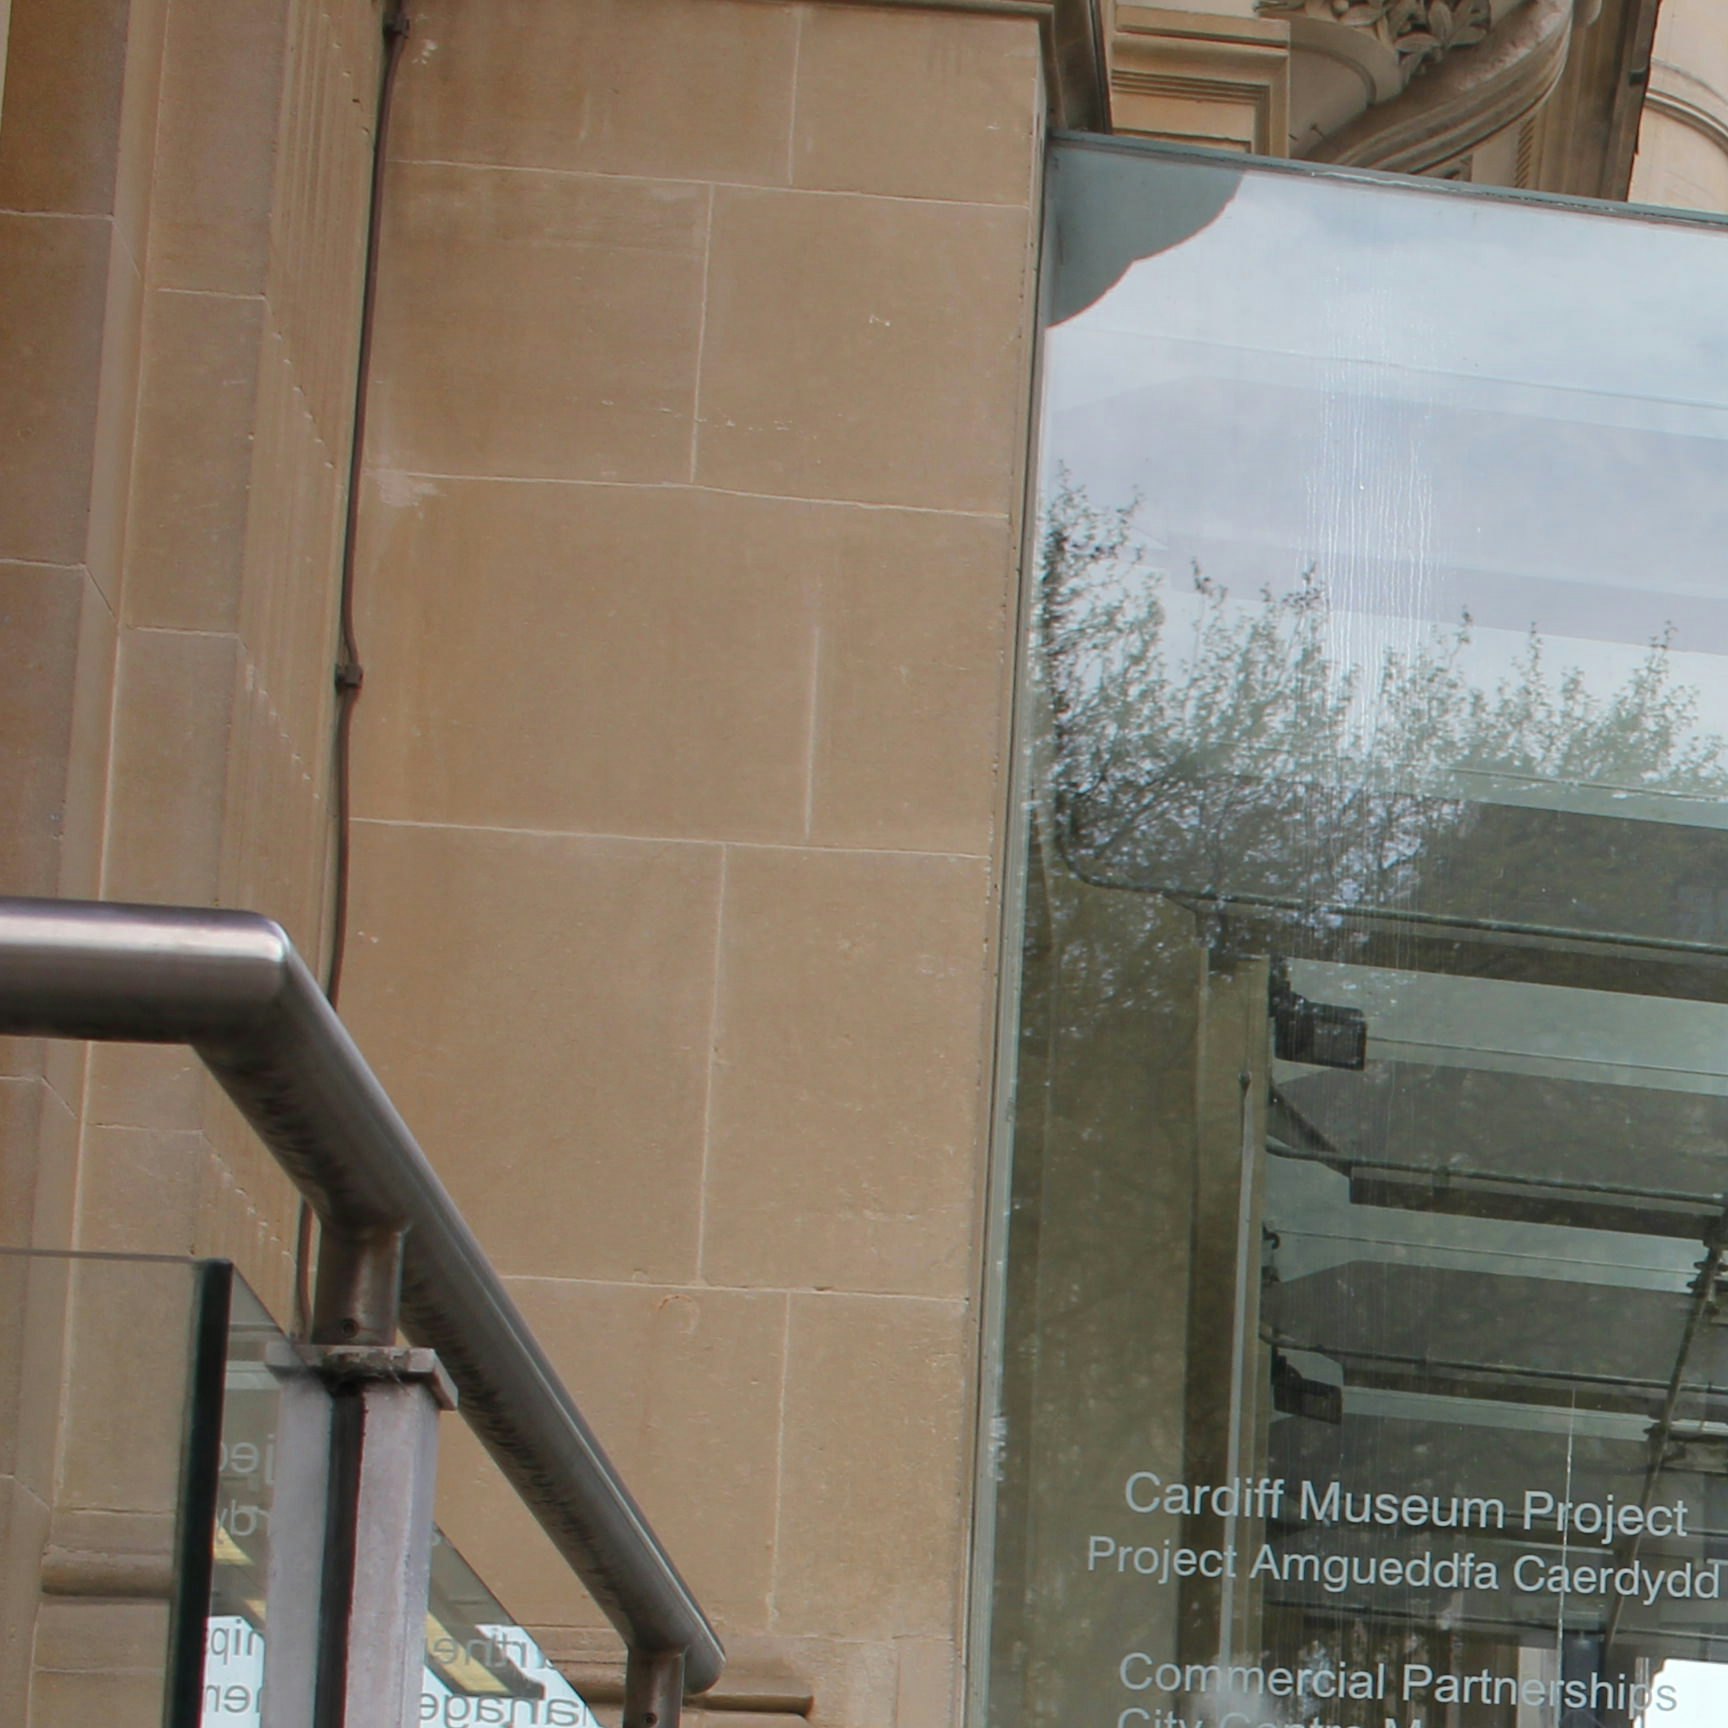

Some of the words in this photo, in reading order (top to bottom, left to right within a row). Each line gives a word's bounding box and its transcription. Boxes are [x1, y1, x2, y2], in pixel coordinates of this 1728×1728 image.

[1123, 1470, 1285, 1519] Cardiff
[1298, 1478, 1506, 1532] Museum
[1522, 1489, 1690, 1545] Project
[1087, 1535, 1238, 1586] Project
[1249, 1542, 1499, 1594] Amgueddfa
[1513, 1554, 1723, 1606] Caerdydd
[1118, 1652, 1386, 1701] Commercial
[1401, 1664, 1679, 1719] Partnerships
